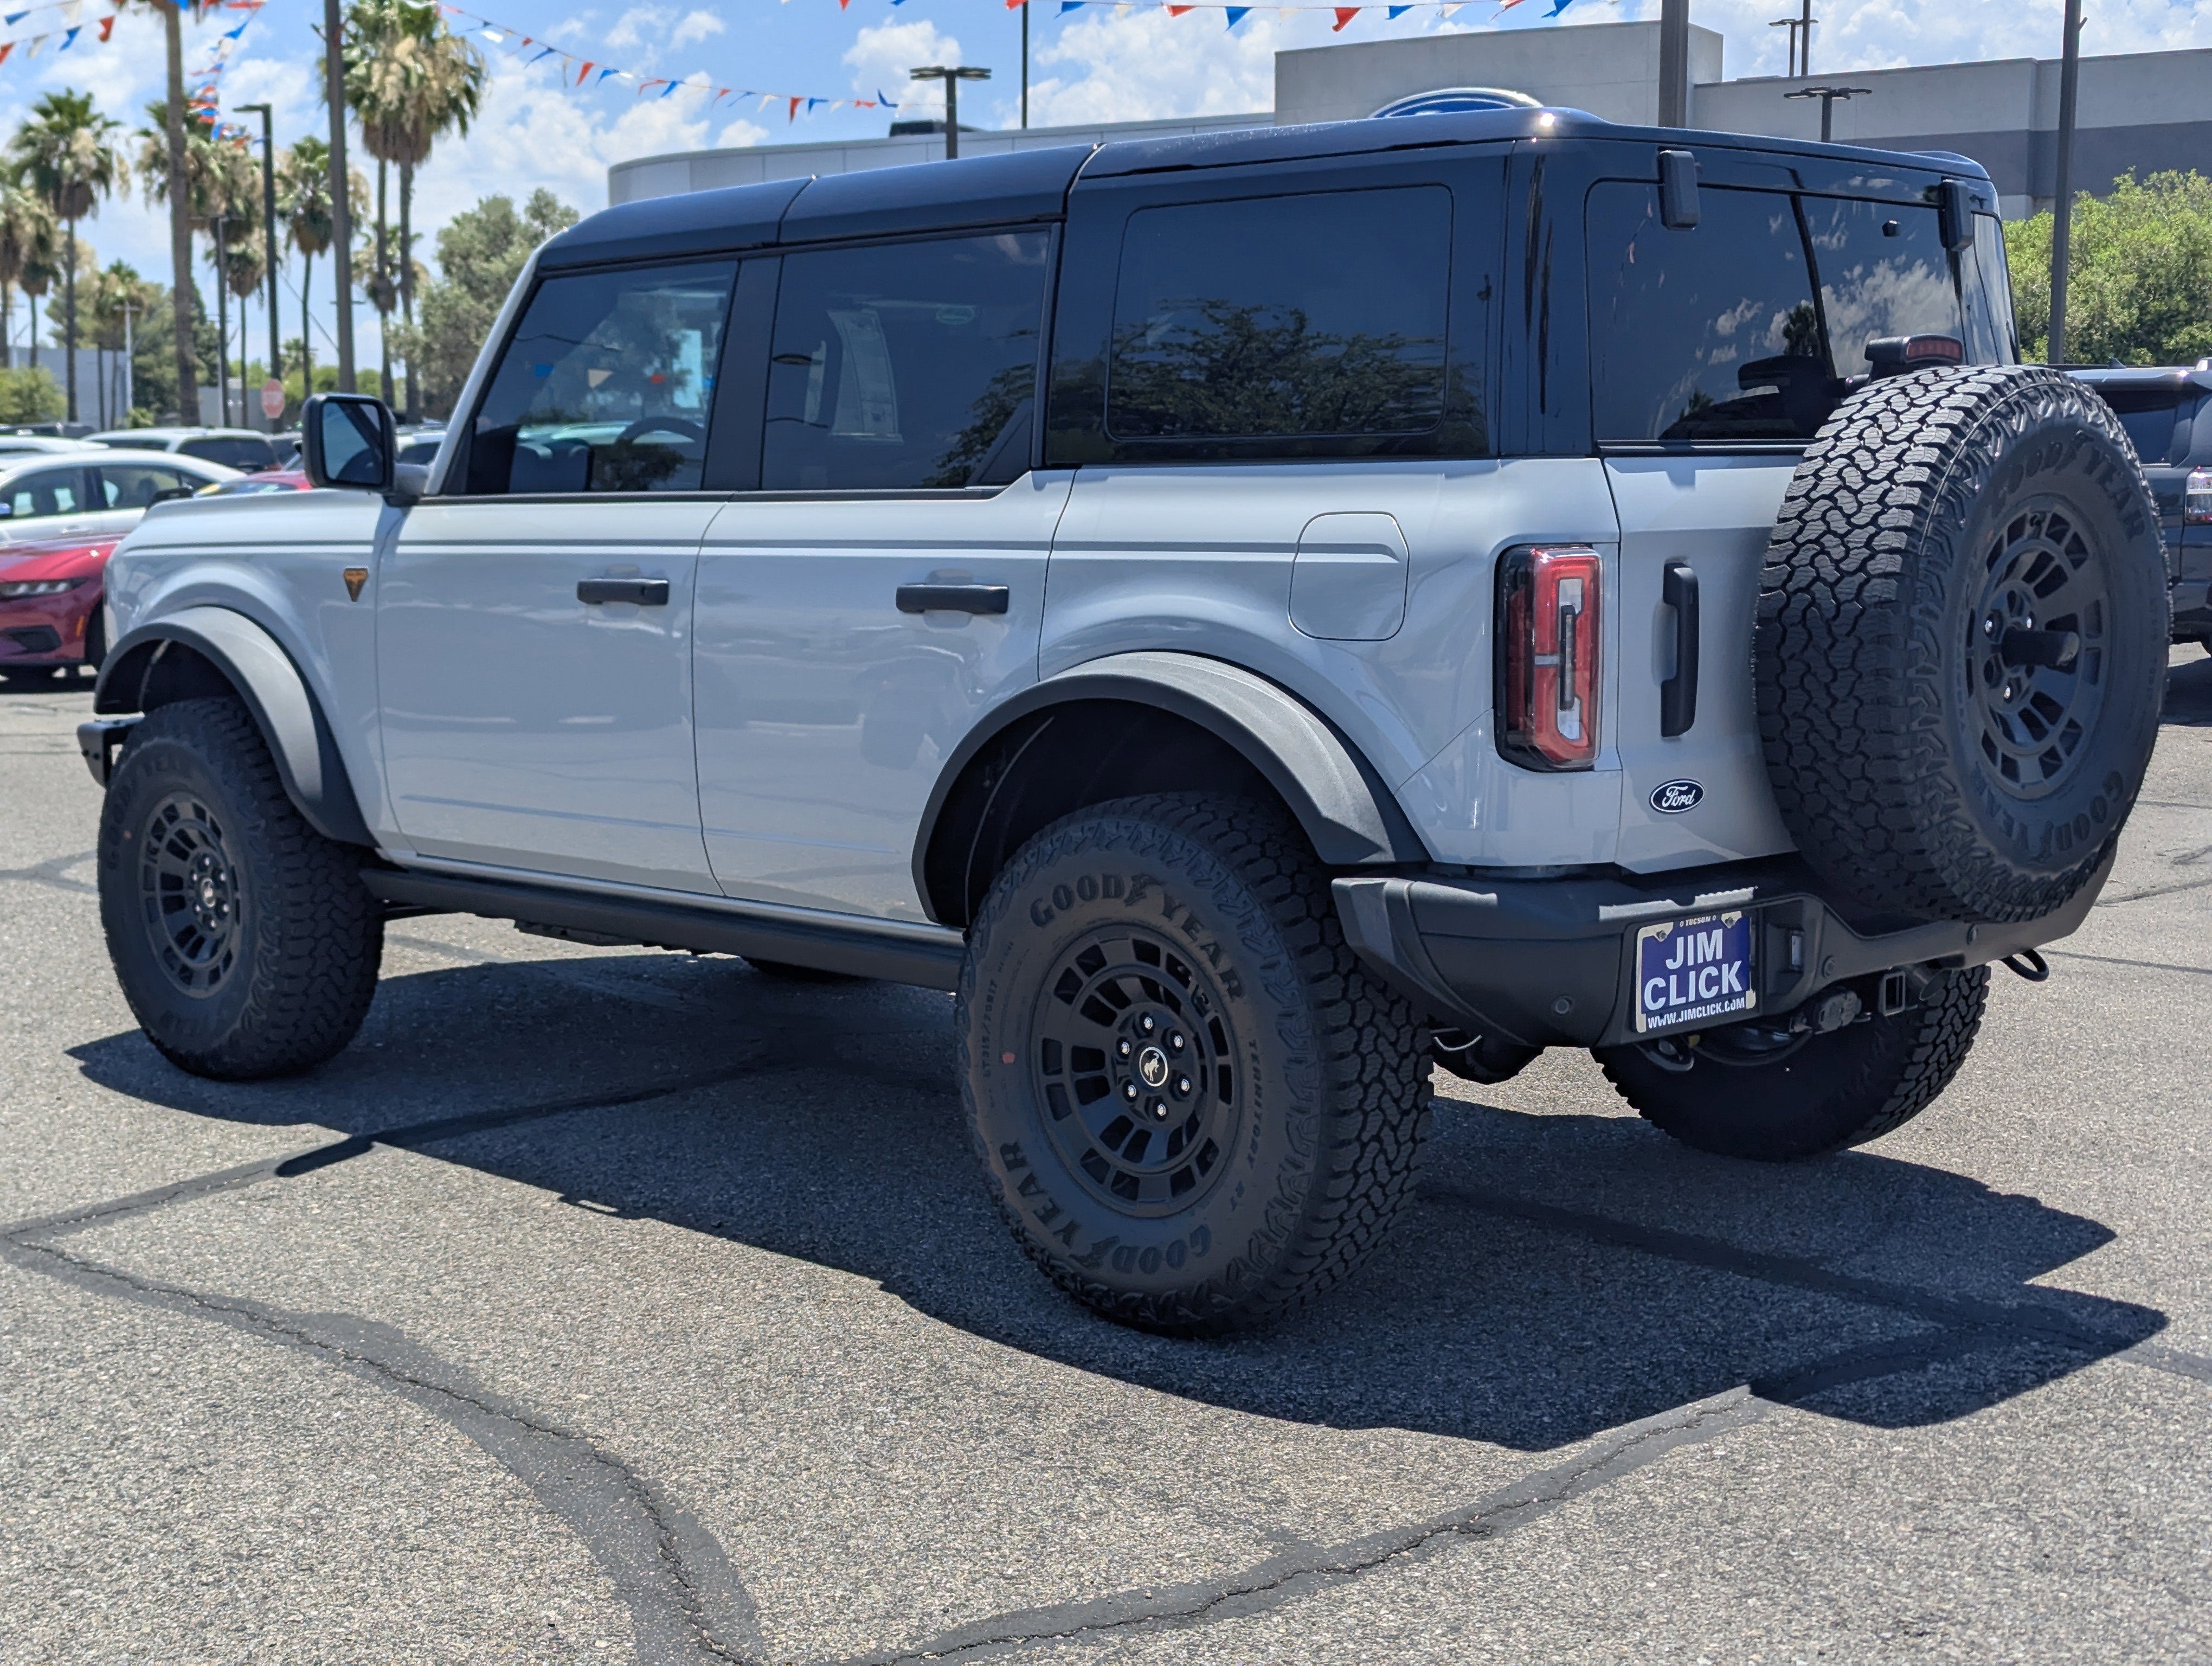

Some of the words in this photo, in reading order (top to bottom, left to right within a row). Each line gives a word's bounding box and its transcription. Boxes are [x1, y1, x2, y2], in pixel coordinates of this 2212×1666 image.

[1662, 785, 1696, 808] Ford
[1685, 915, 1711, 926] TUCSON
[1666, 928, 1723, 970] JIM
[1644, 960, 1742, 1010] CLICK
[1648, 997, 1745, 1029] WWW.JIMCLICK.COM
[1246, 1038, 1263, 1170] TERRITORY
